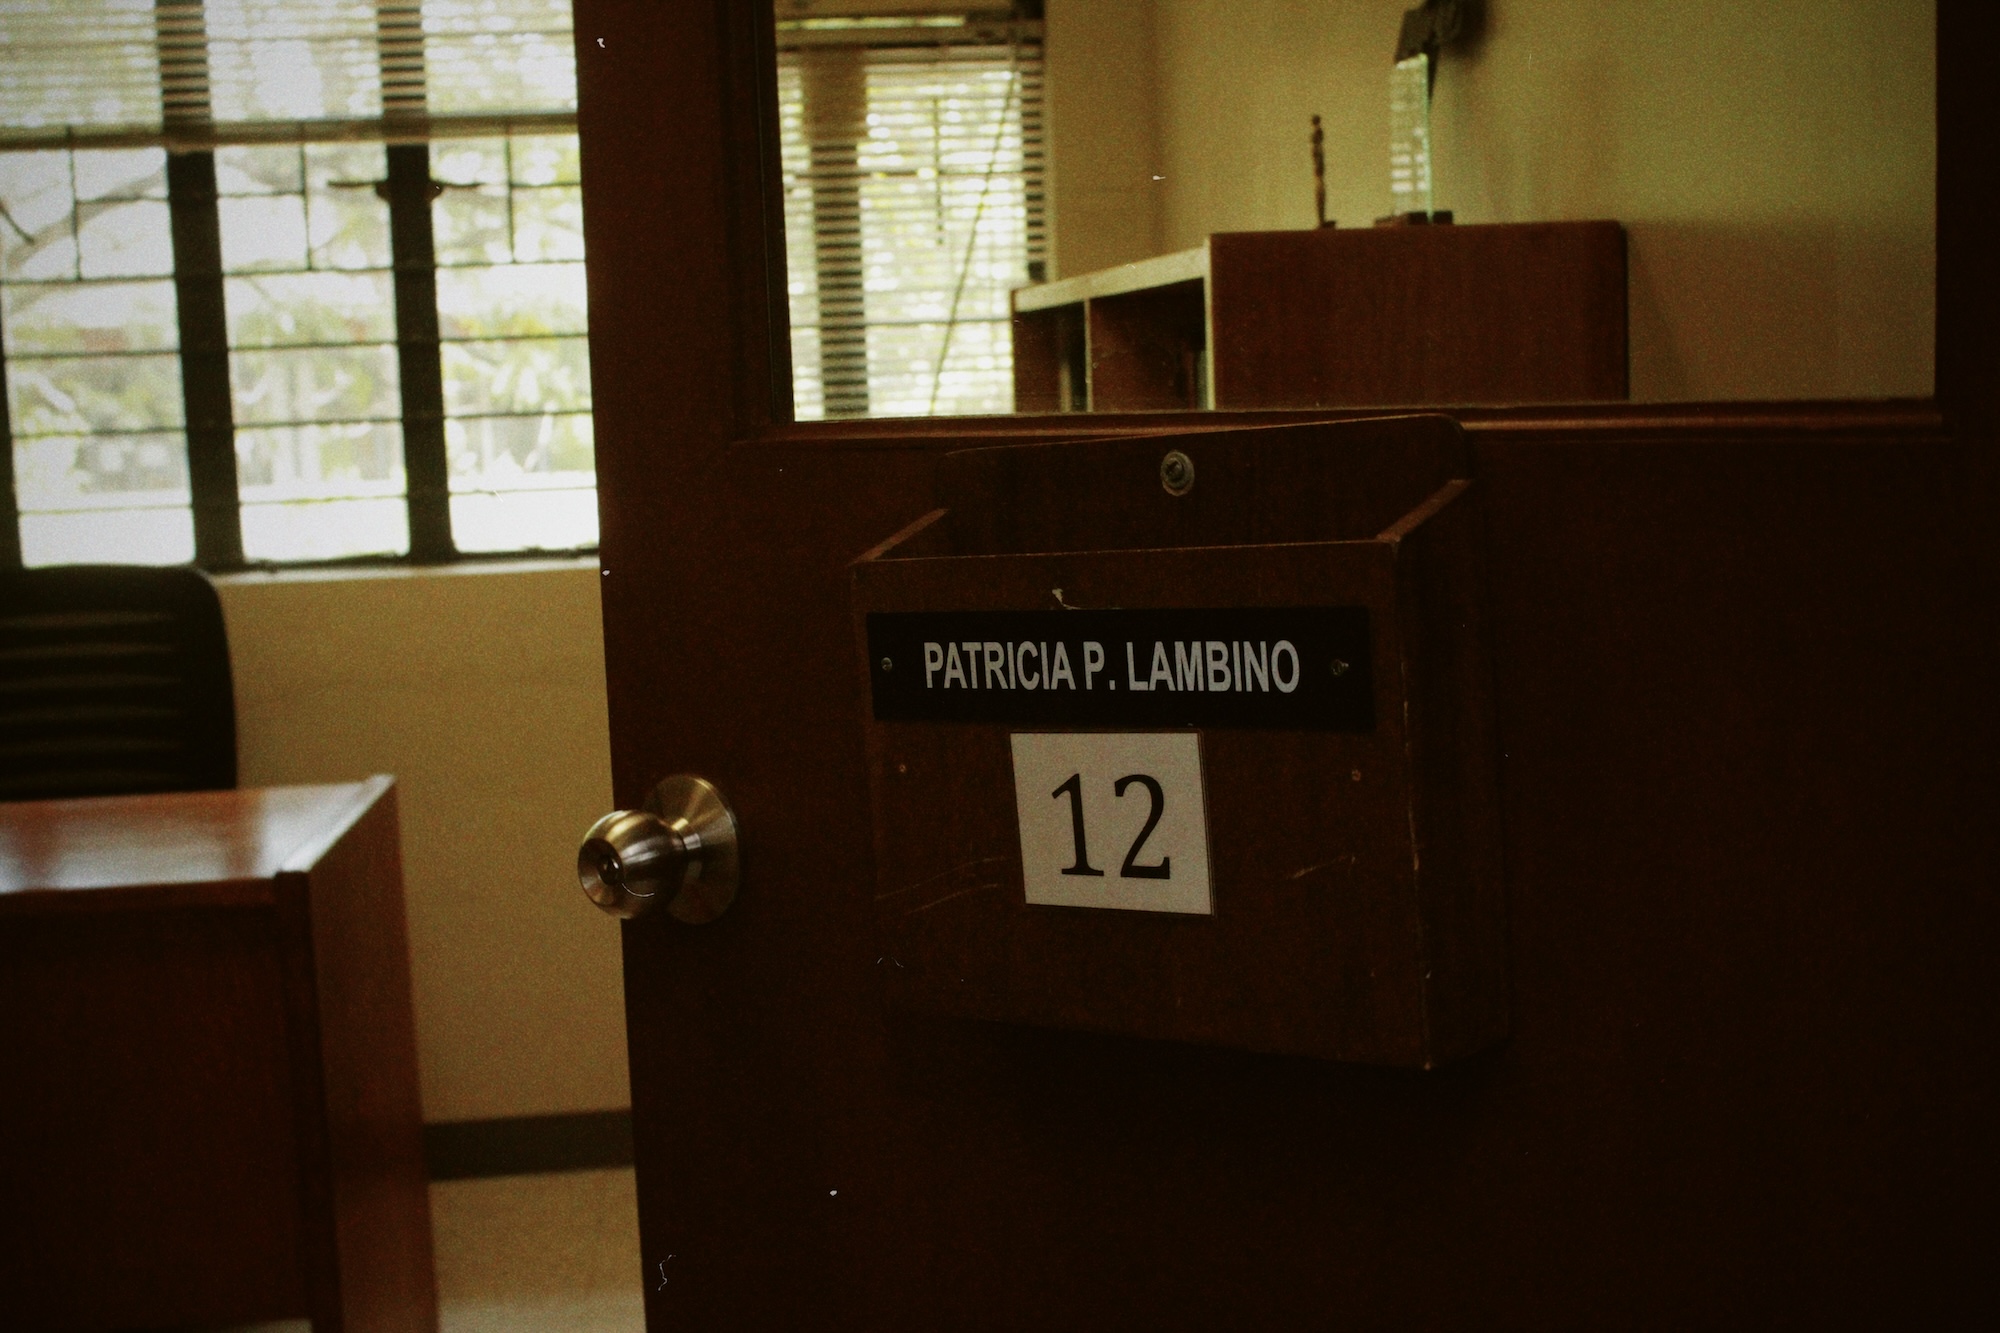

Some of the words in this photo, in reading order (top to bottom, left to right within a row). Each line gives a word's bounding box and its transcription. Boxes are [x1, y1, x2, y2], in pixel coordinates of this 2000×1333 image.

[923, 641, 1077, 690] PATRICIA
[1083, 641, 1116, 690] P.
[1126, 640, 1300, 693] LAMBINO
[1051, 773, 1170, 879] 12
